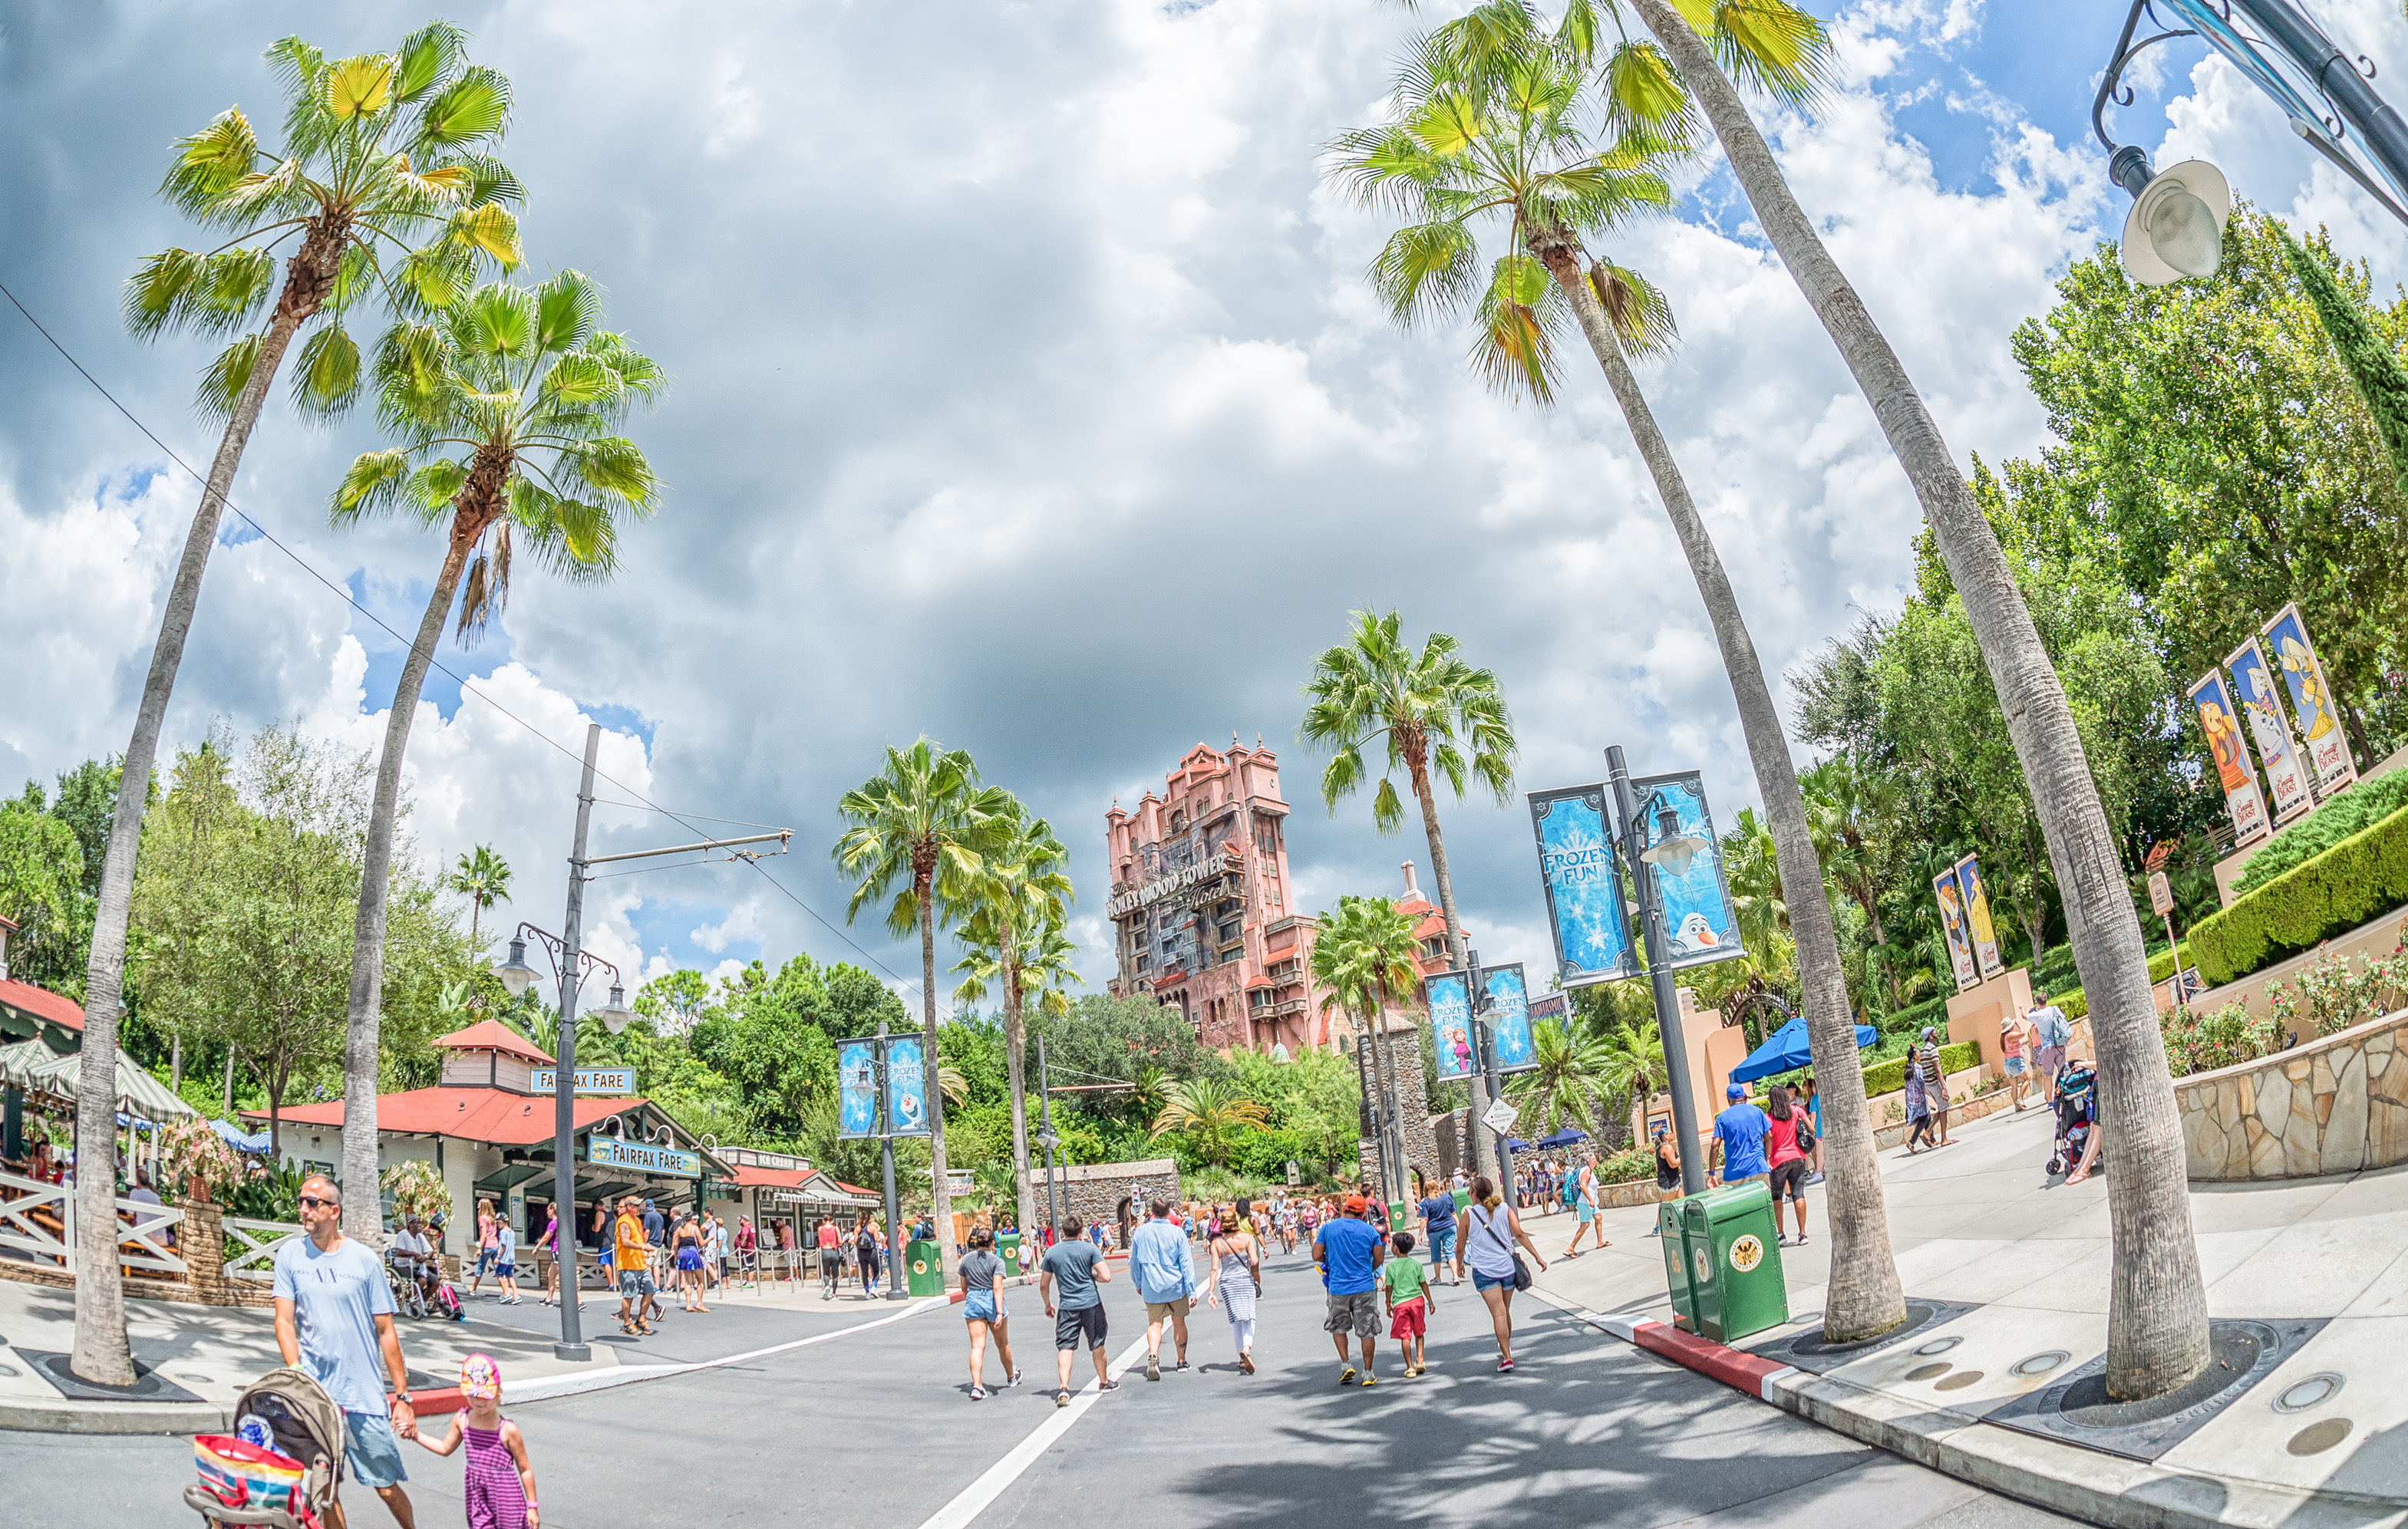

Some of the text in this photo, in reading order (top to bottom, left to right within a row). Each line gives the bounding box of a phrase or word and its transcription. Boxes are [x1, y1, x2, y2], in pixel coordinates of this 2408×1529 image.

[2318, 753, 2340, 772] BEAST
[2278, 783, 2297, 800] BEAST
[2237, 808, 2256, 825] BEAST
[1544, 845, 1614, 873] FROZEN
[1563, 865, 1598, 885] FUN
[1106, 852, 1228, 918] HOLLYWOOD TOWER
[1113, 880, 1134, 897] The
[1186, 875, 1228, 909] Hotel
[1494, 997, 1526, 1007] ROZEN
[1530, 996, 1565, 1018] FANTASMIC!
[1431, 1004, 1470, 1018] FROZEN
[1443, 1014, 1462, 1026] FUN
[593, 1073, 624, 1088] FARE
[888, 1066, 922, 1079] FROZEN
[897, 1075, 915, 1085] FUN
[613, 1144, 682, 1170] FAIRFAX FARE
[760, 1153, 794, 1168] ICE CREAM
[1752, 1237, 1760, 1247] KEEP
[1733, 1260, 1741, 1269] OUR
[1752, 1253, 1761, 1267] CLEAN
